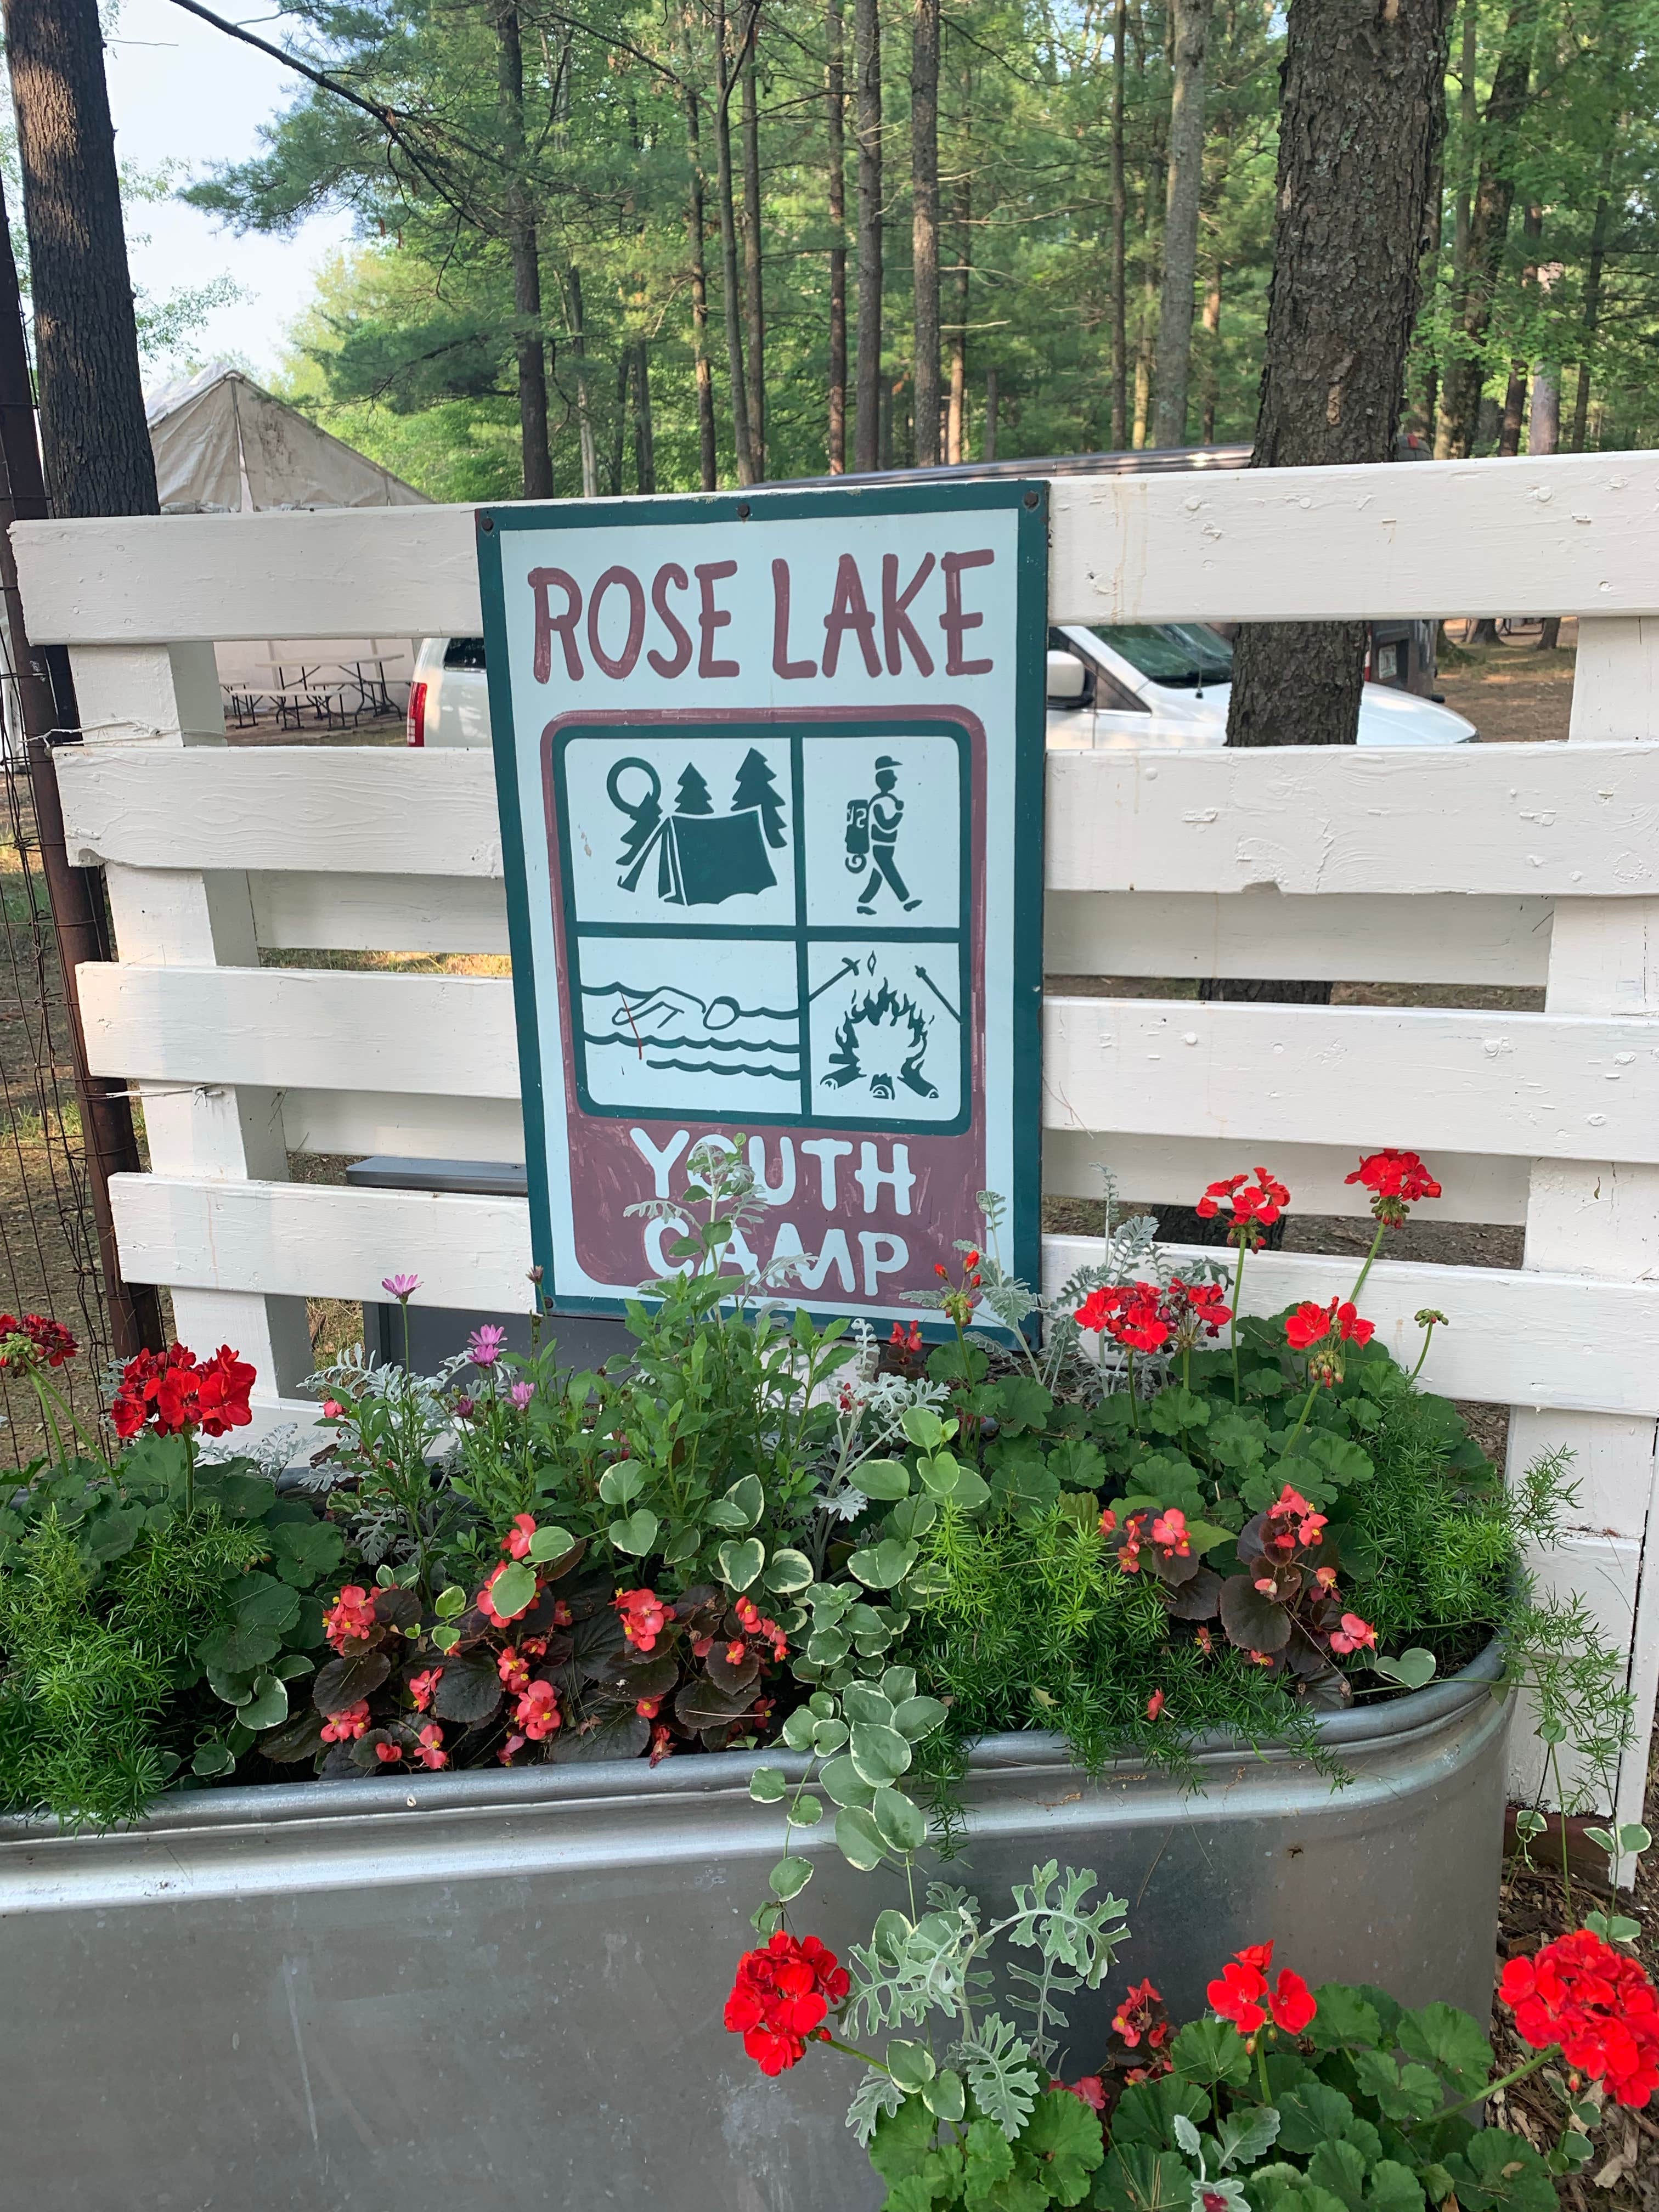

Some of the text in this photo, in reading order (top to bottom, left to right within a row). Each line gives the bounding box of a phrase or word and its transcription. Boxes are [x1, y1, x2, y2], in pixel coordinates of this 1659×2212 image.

[527, 549, 994, 684] ROSE LAKE
[629, 1127, 916, 1216] YOUTH
[644, 1216, 910, 1296] CAMP
